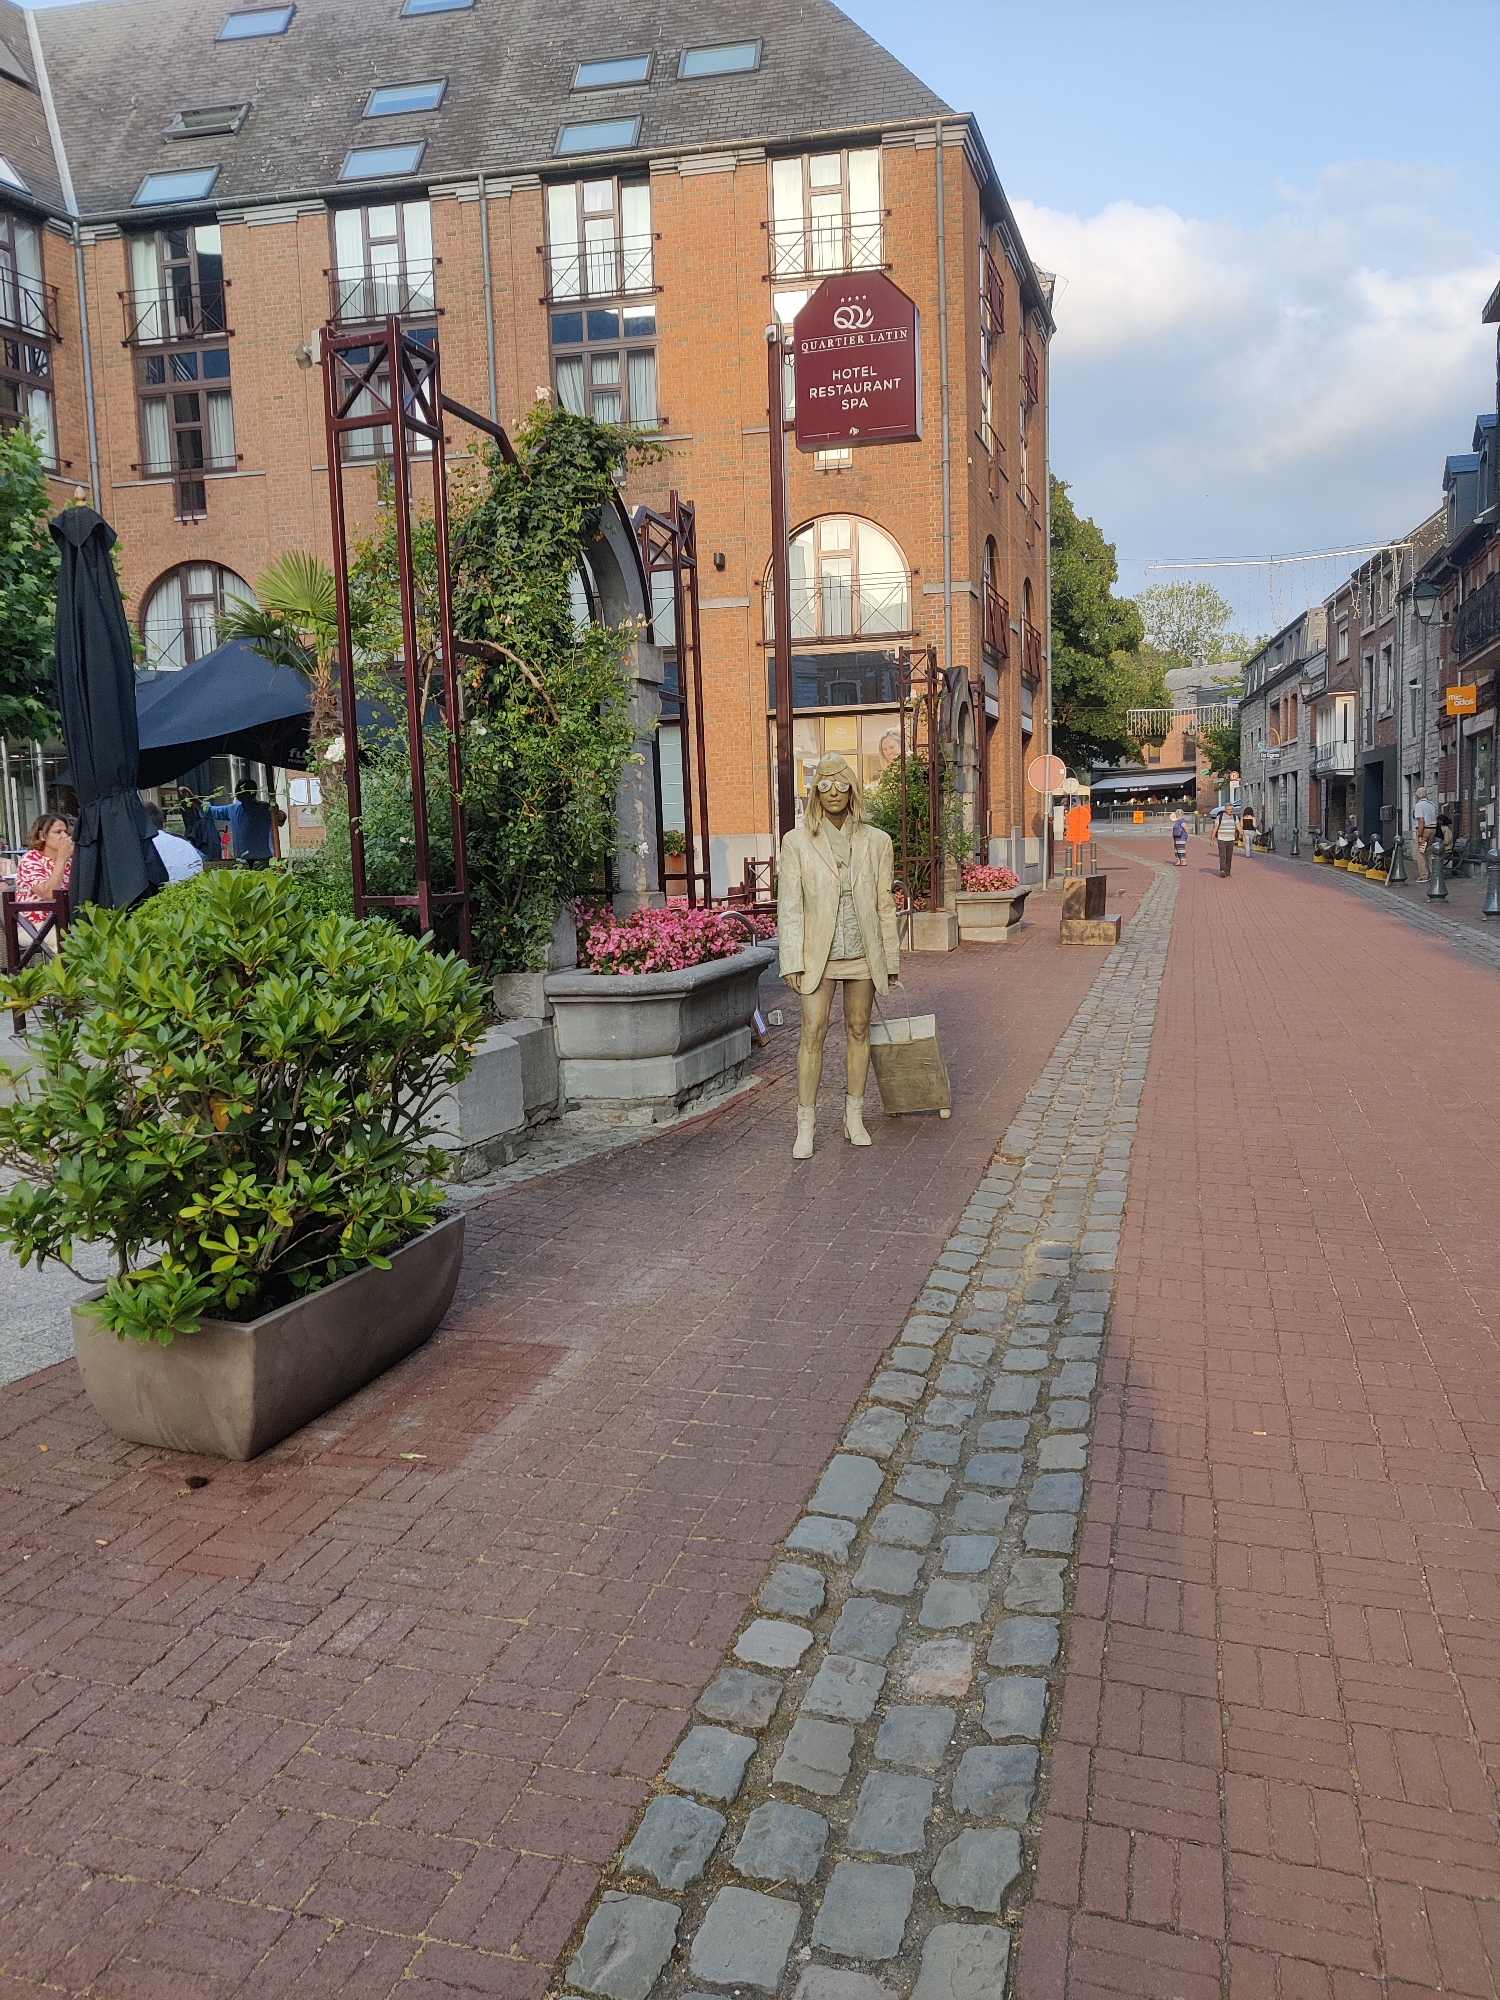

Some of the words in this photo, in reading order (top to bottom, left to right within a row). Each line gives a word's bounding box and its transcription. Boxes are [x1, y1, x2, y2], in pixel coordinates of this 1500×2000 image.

[801, 334, 865, 352] QUARTIER
[870, 329, 908, 343] LATIN
[832, 365, 878, 381] HOTEL
[809, 377, 902, 399] RESTAURANT
[841, 397, 869, 410] SPA
